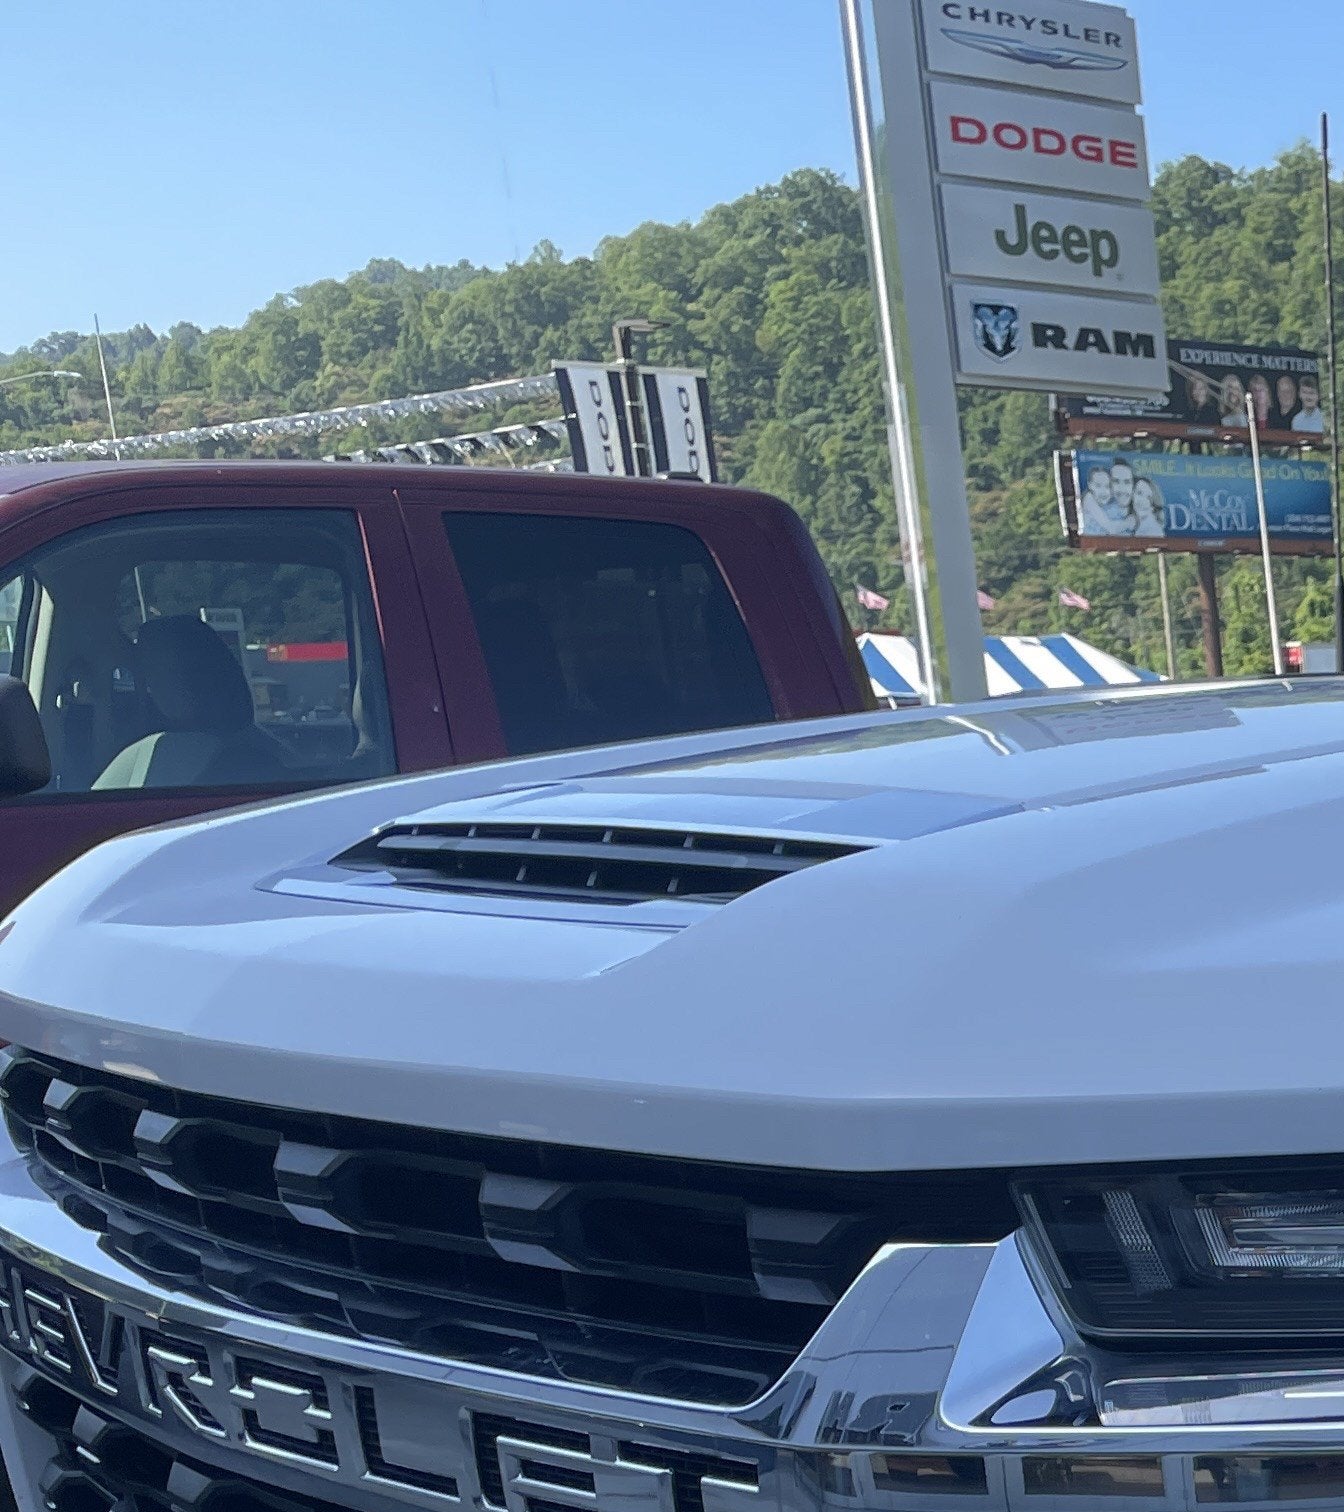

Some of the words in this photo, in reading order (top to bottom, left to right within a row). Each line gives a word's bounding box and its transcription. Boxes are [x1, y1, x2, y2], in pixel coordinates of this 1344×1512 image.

[942, 3, 1123, 48] CHRYSLER
[950, 115, 1139, 169] DODGE
[994, 203, 1120, 277] Jeep
[1030, 321, 1156, 359] RAM
[1180, 347, 1260, 369] EXPERIENCE
